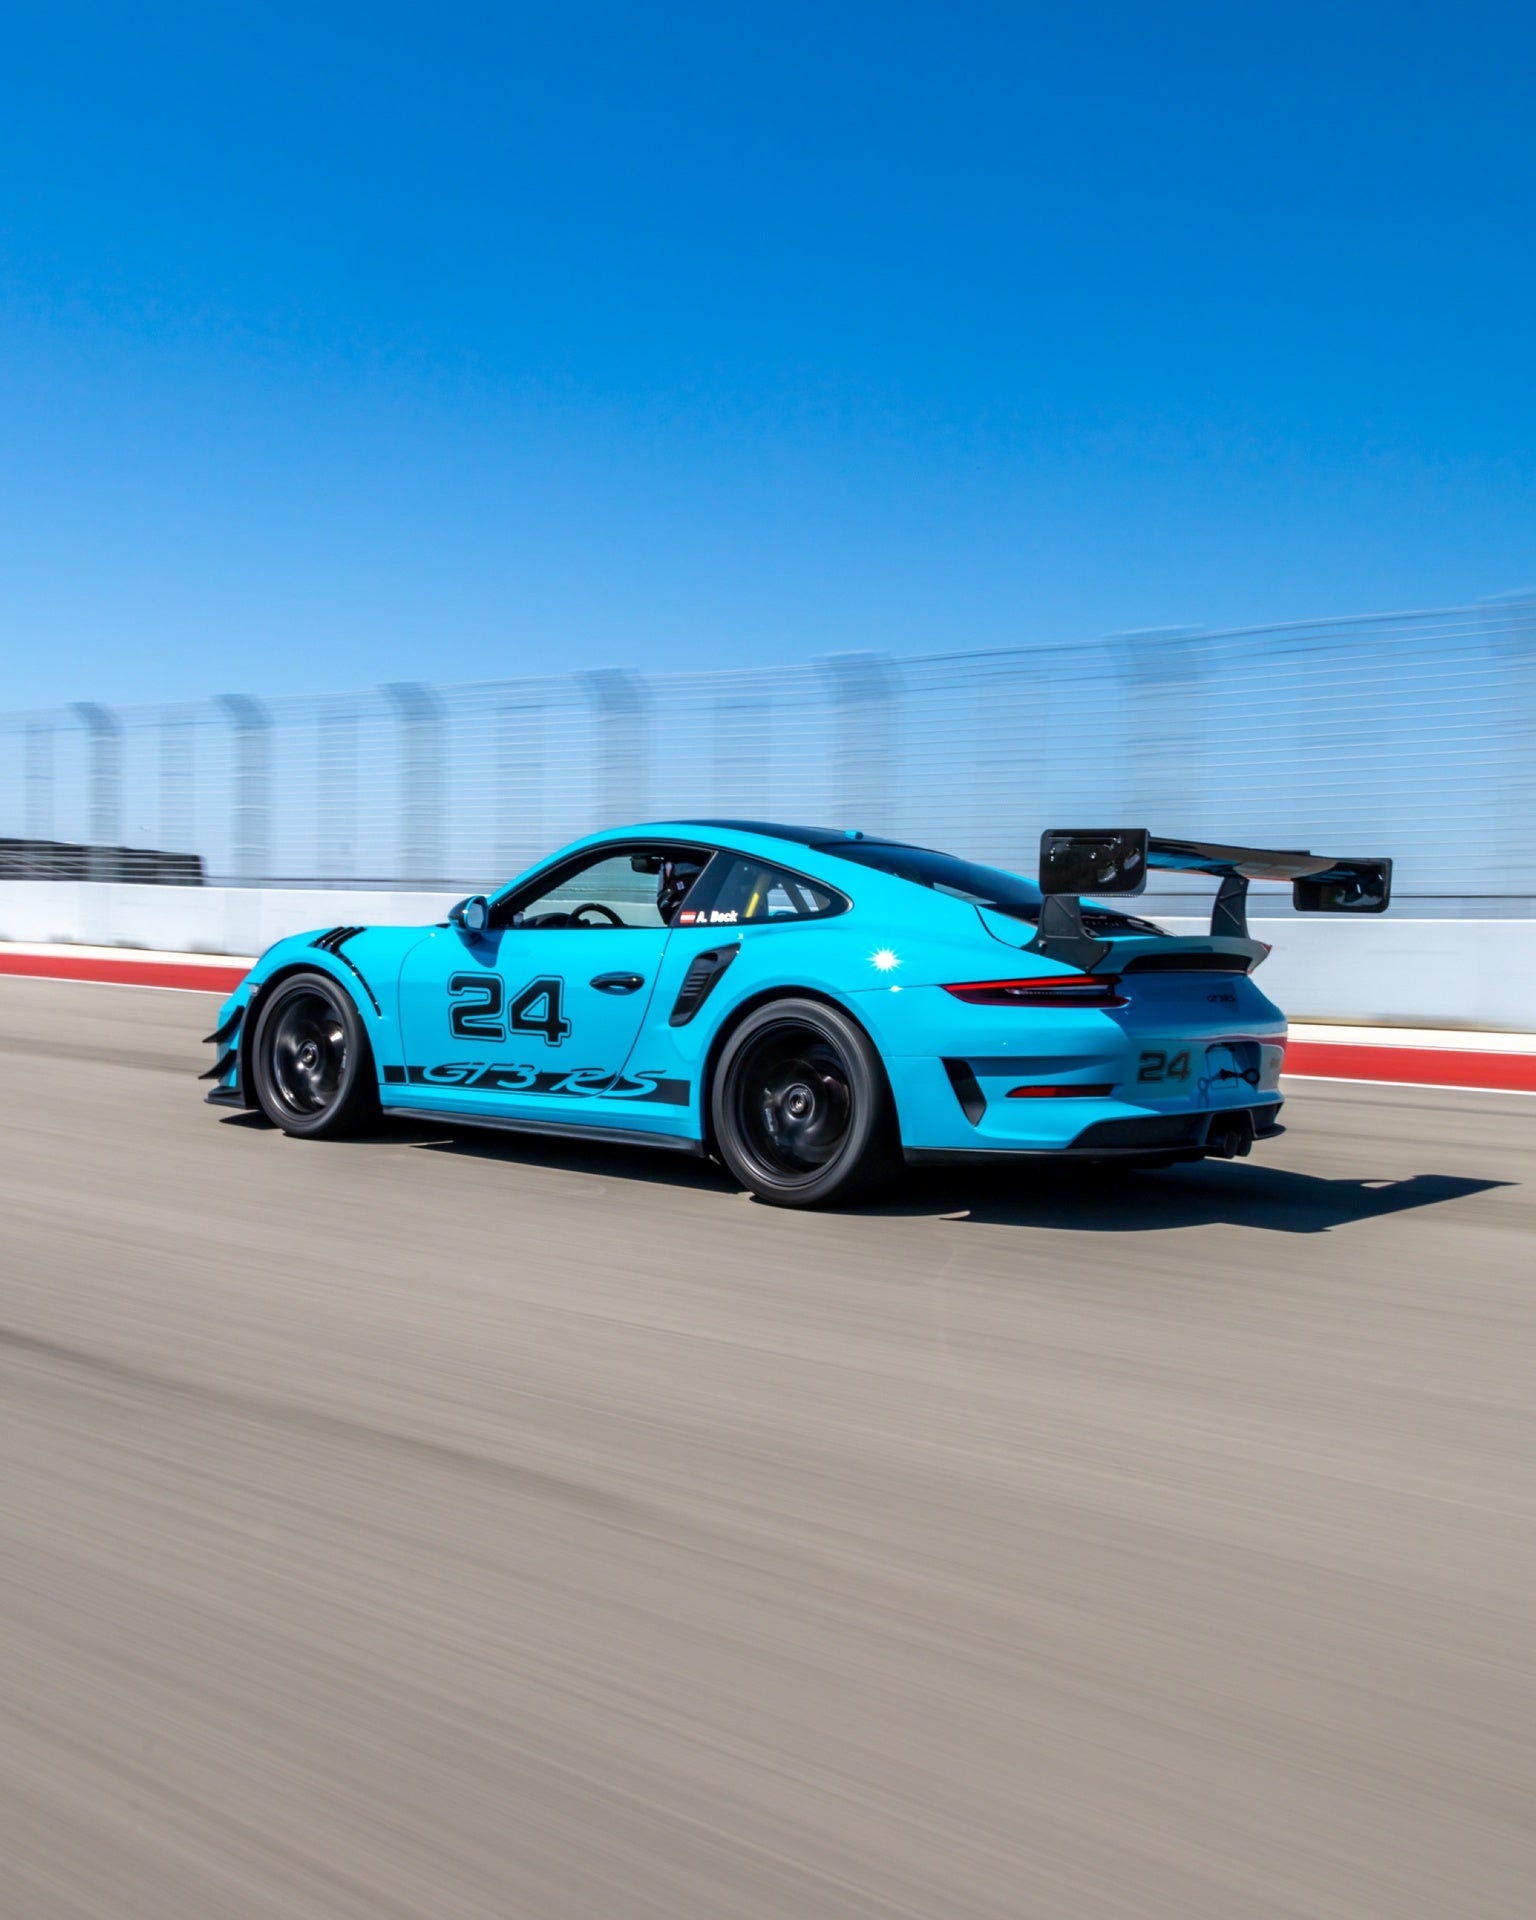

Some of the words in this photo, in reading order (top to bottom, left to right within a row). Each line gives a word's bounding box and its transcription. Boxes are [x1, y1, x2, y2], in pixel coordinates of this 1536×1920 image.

[696, 910, 708, 923] A.
[447, 971, 571, 1047] 24
[423, 1061, 541, 1089] GT3
[550, 1067, 667, 1097] RS
[1137, 1050, 1191, 1084] 24
